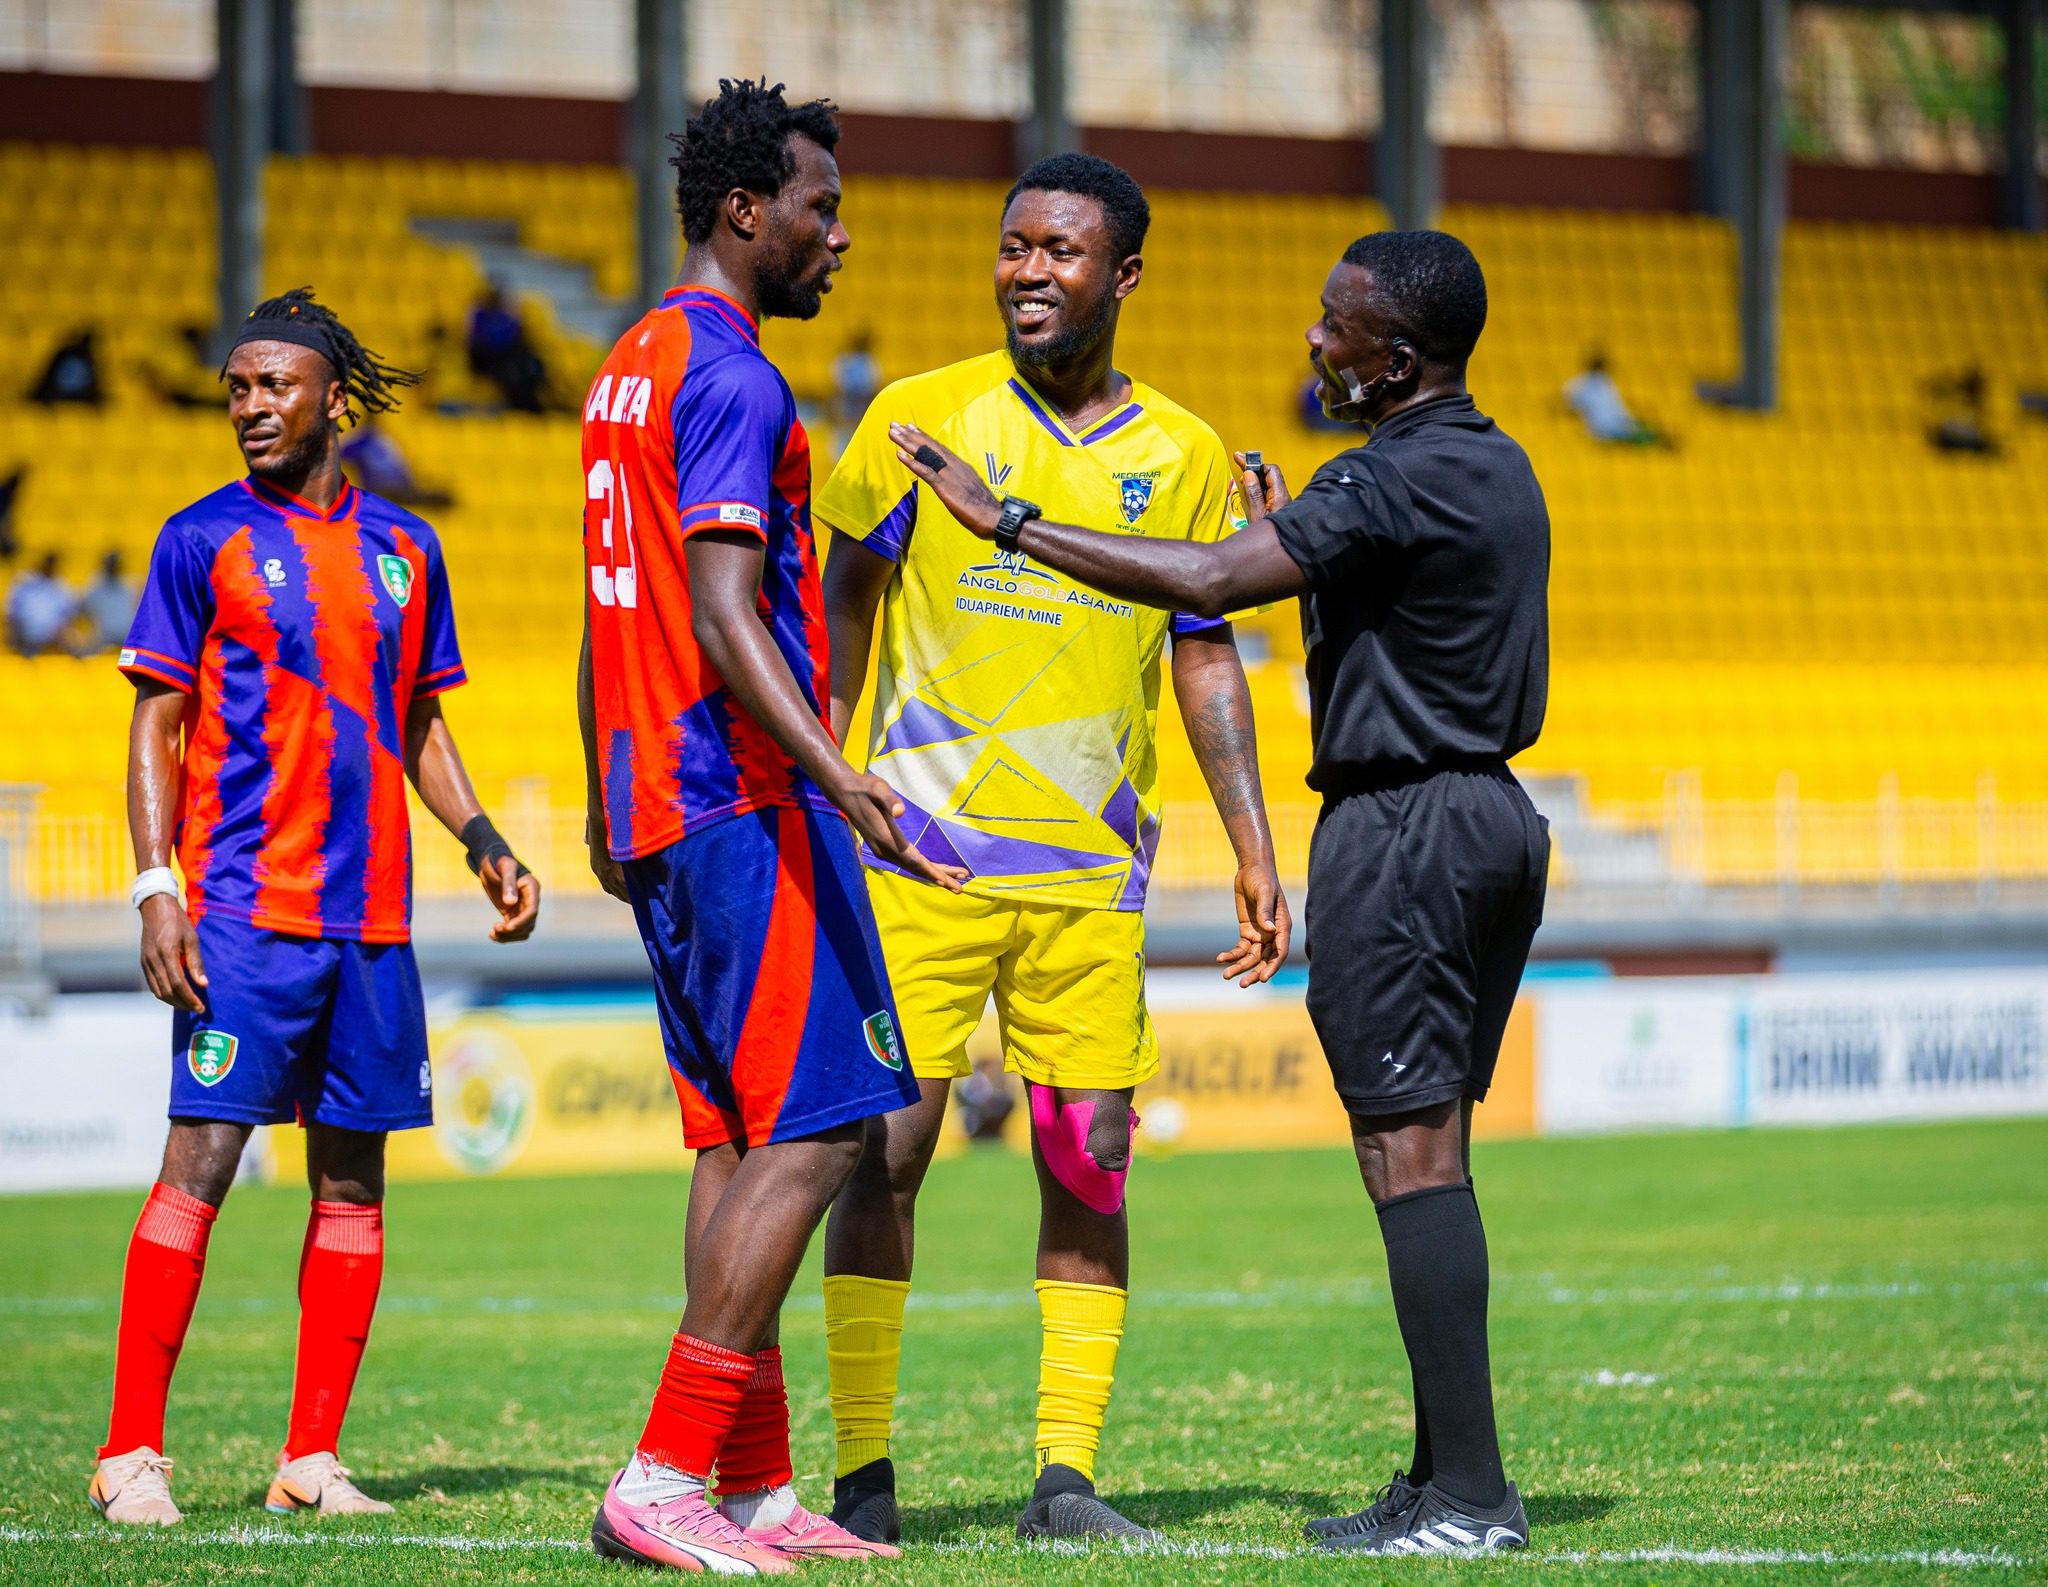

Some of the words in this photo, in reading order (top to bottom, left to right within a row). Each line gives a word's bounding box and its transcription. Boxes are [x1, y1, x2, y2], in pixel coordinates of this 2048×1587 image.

[586, 375, 652, 427] AKA
[1139, 479, 1153, 487] SC
[955, 597, 1024, 620] IDUAPRIEM
[1027, 609, 1062, 626] MINE
